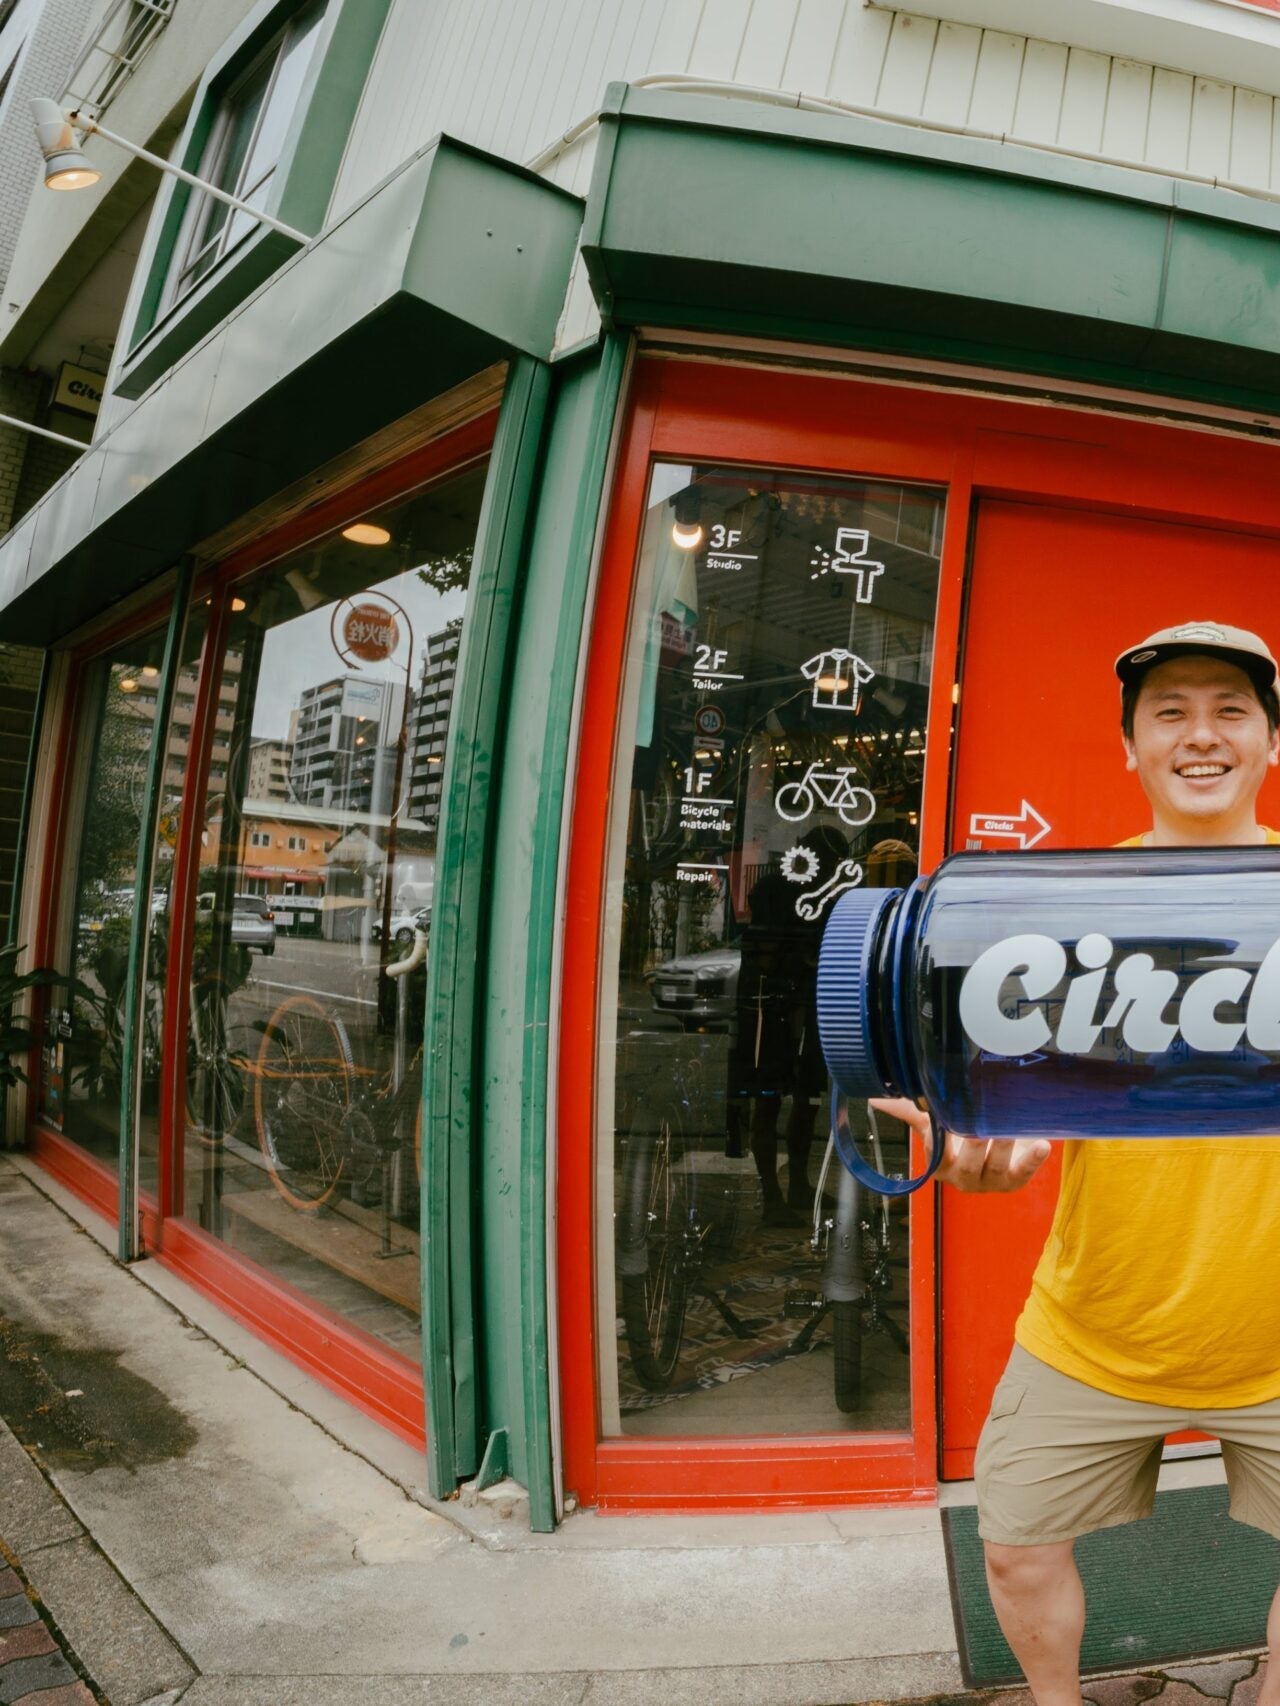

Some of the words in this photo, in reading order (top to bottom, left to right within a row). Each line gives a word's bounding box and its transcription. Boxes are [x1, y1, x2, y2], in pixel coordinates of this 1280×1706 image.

[709, 524, 742, 548] 3F
[706, 558, 742, 571] Studio
[694, 644, 729, 670] 2F
[692, 678, 723, 691] Tailor
[683, 766, 713, 793] 1F
[680, 803, 720, 818] Bicycle
[679, 819, 732, 832] materials
[676, 869, 713, 883] Repair
